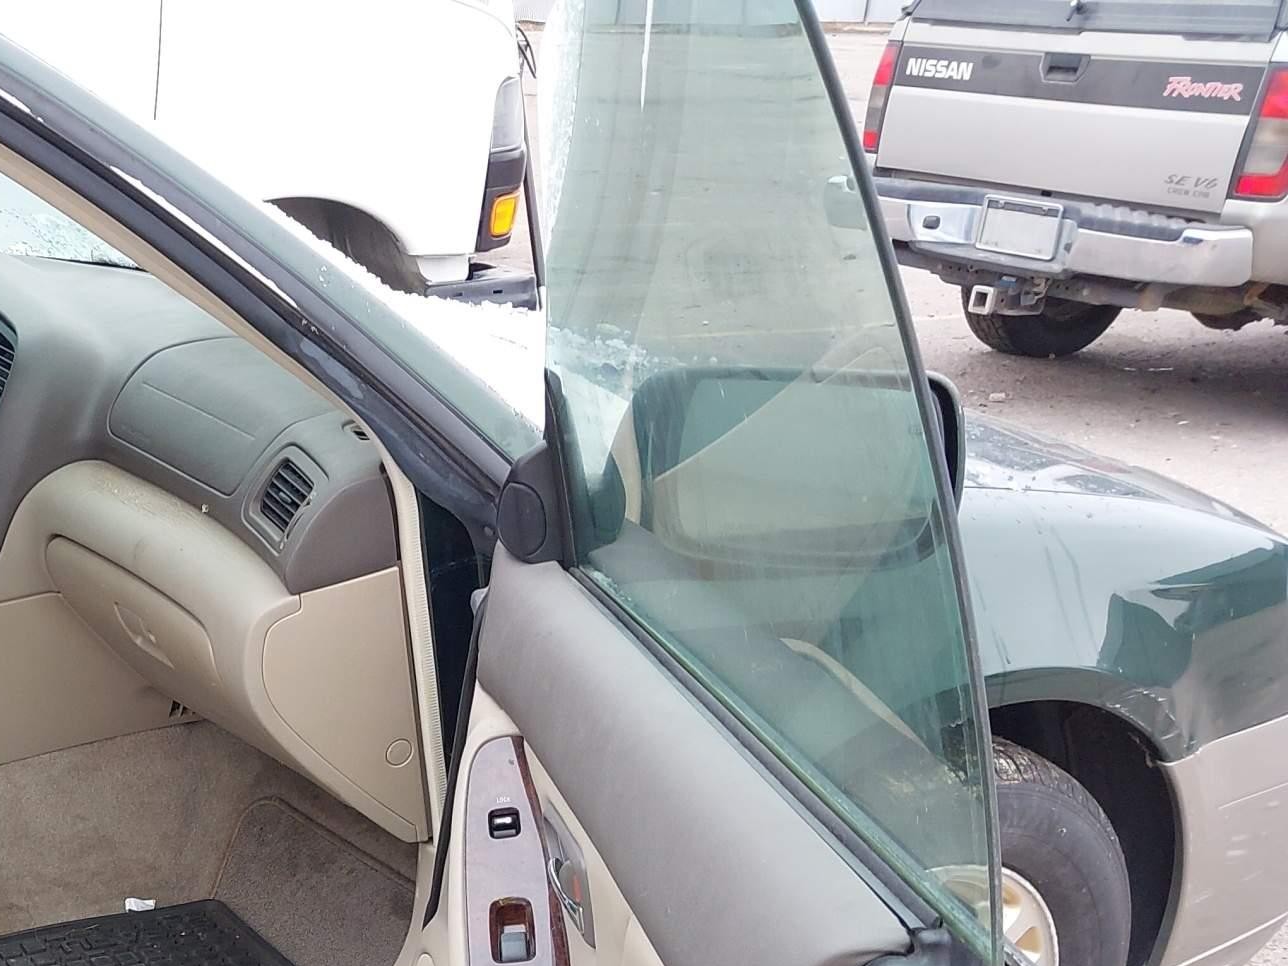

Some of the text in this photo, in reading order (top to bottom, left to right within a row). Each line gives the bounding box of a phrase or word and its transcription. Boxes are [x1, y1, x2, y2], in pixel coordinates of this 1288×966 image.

[905, 57, 974, 81] NISSAN
[1163, 174, 1218, 190] SE V6
